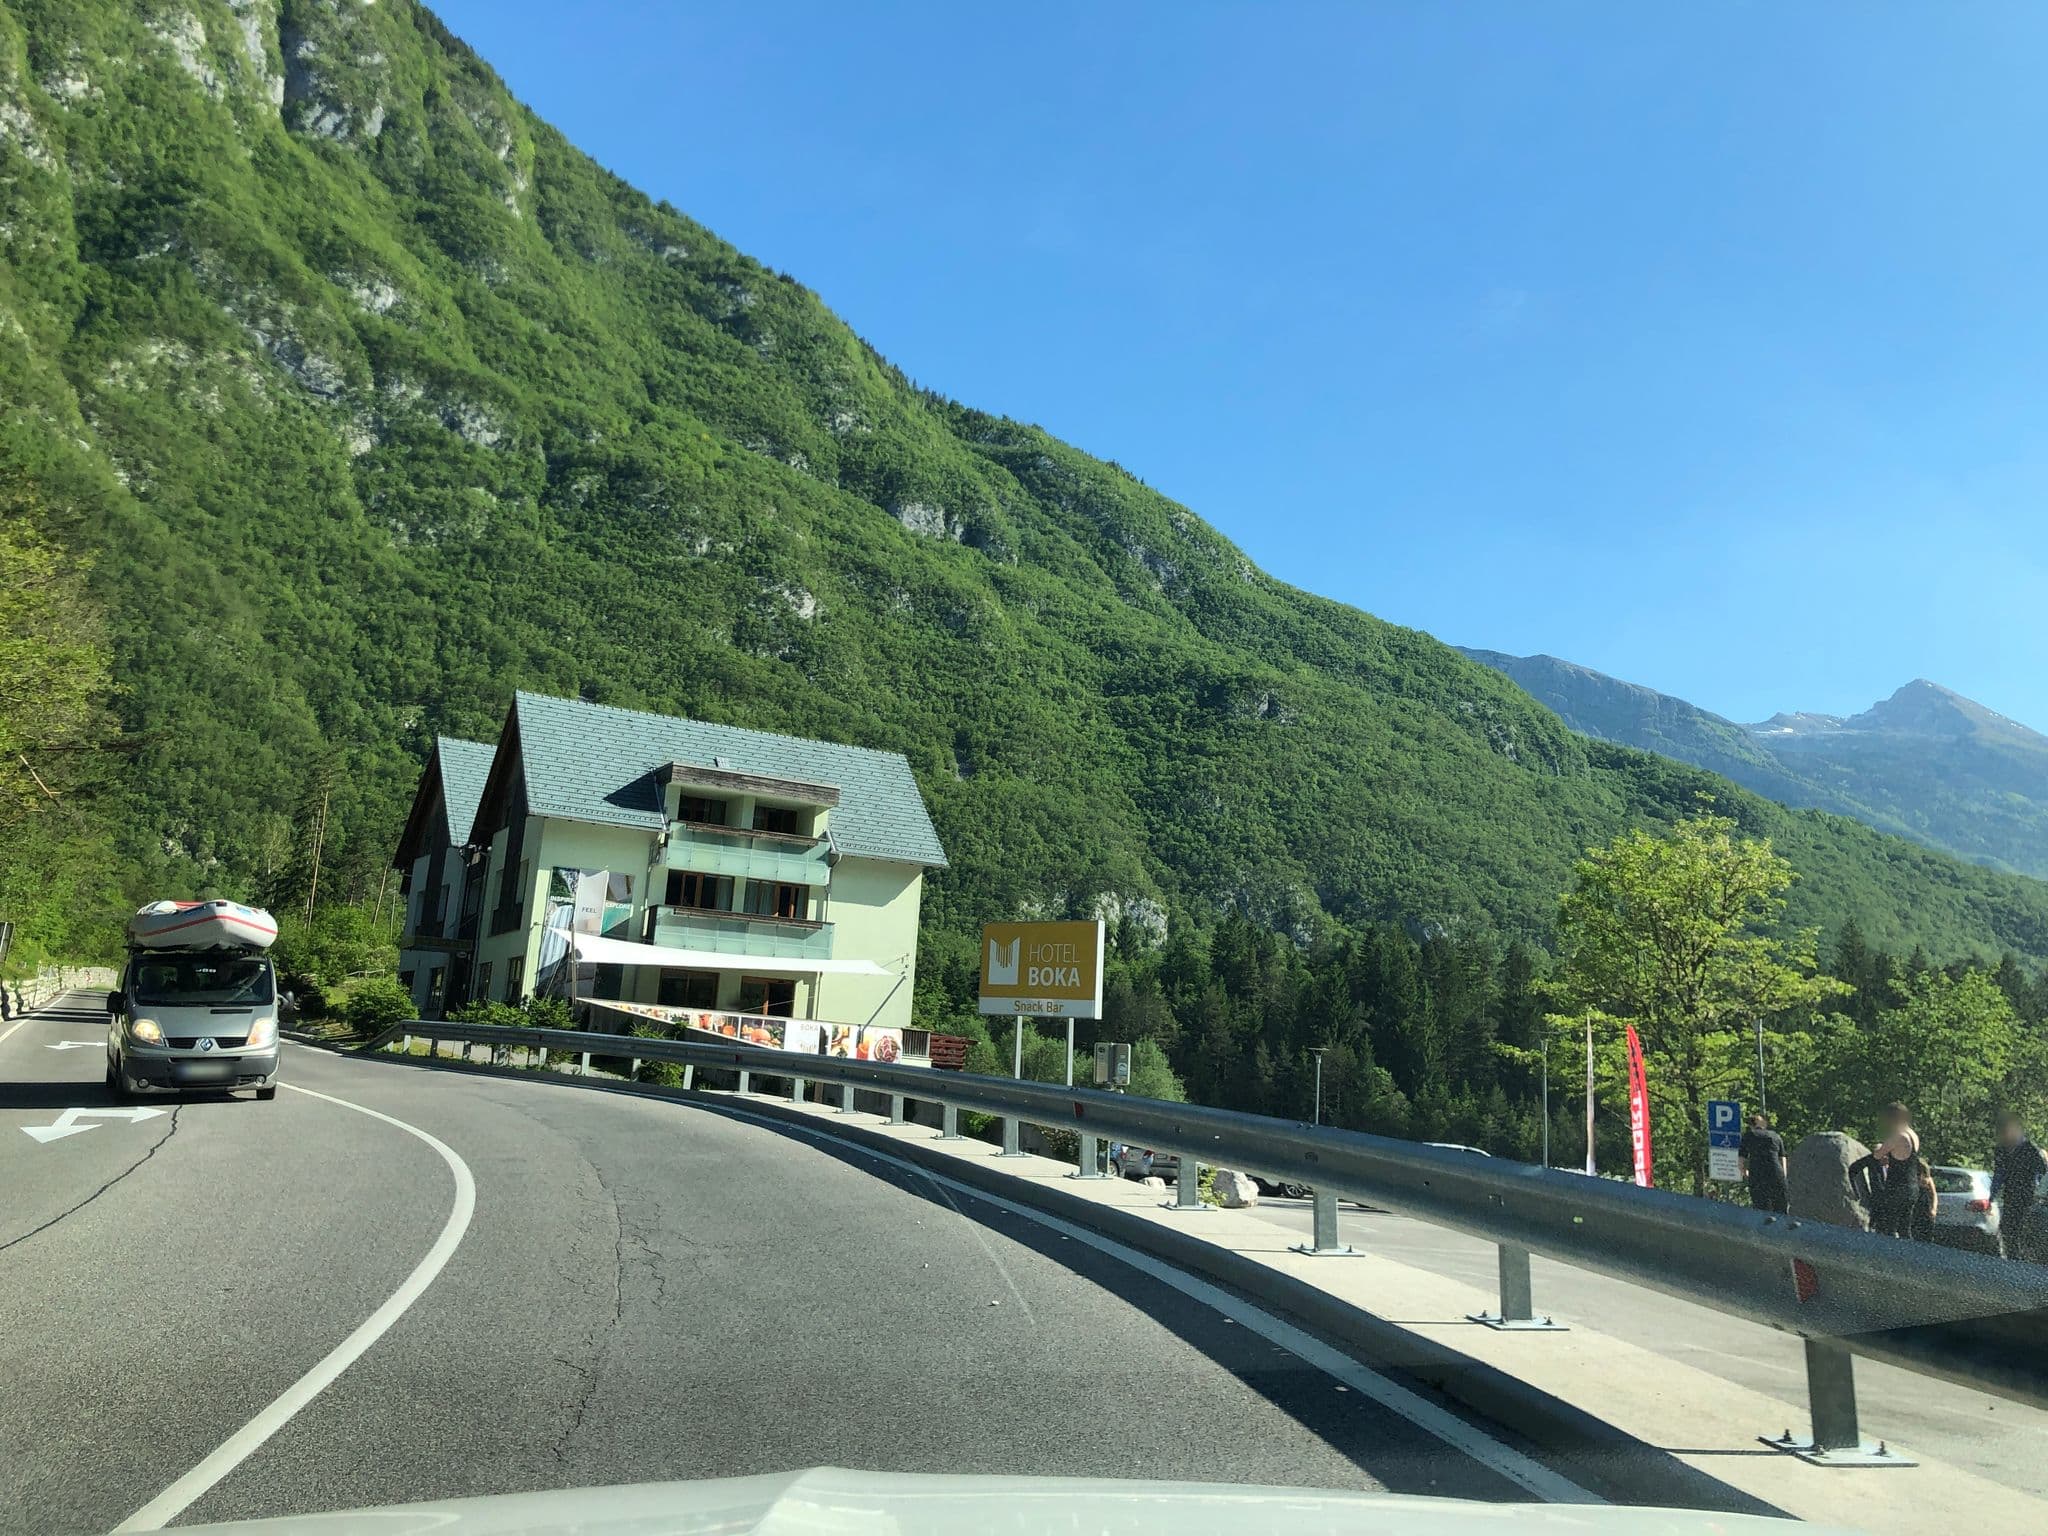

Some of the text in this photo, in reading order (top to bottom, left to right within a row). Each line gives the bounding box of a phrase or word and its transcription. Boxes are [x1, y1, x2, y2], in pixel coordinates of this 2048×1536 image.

[581, 906, 597, 914] FEEL
[1028, 943, 1080, 963] HOTEL
[1029, 967, 1081, 987] BOKA
[1014, 1000, 1064, 1013] Snack Bar
[1715, 1104, 1733, 1128] P
